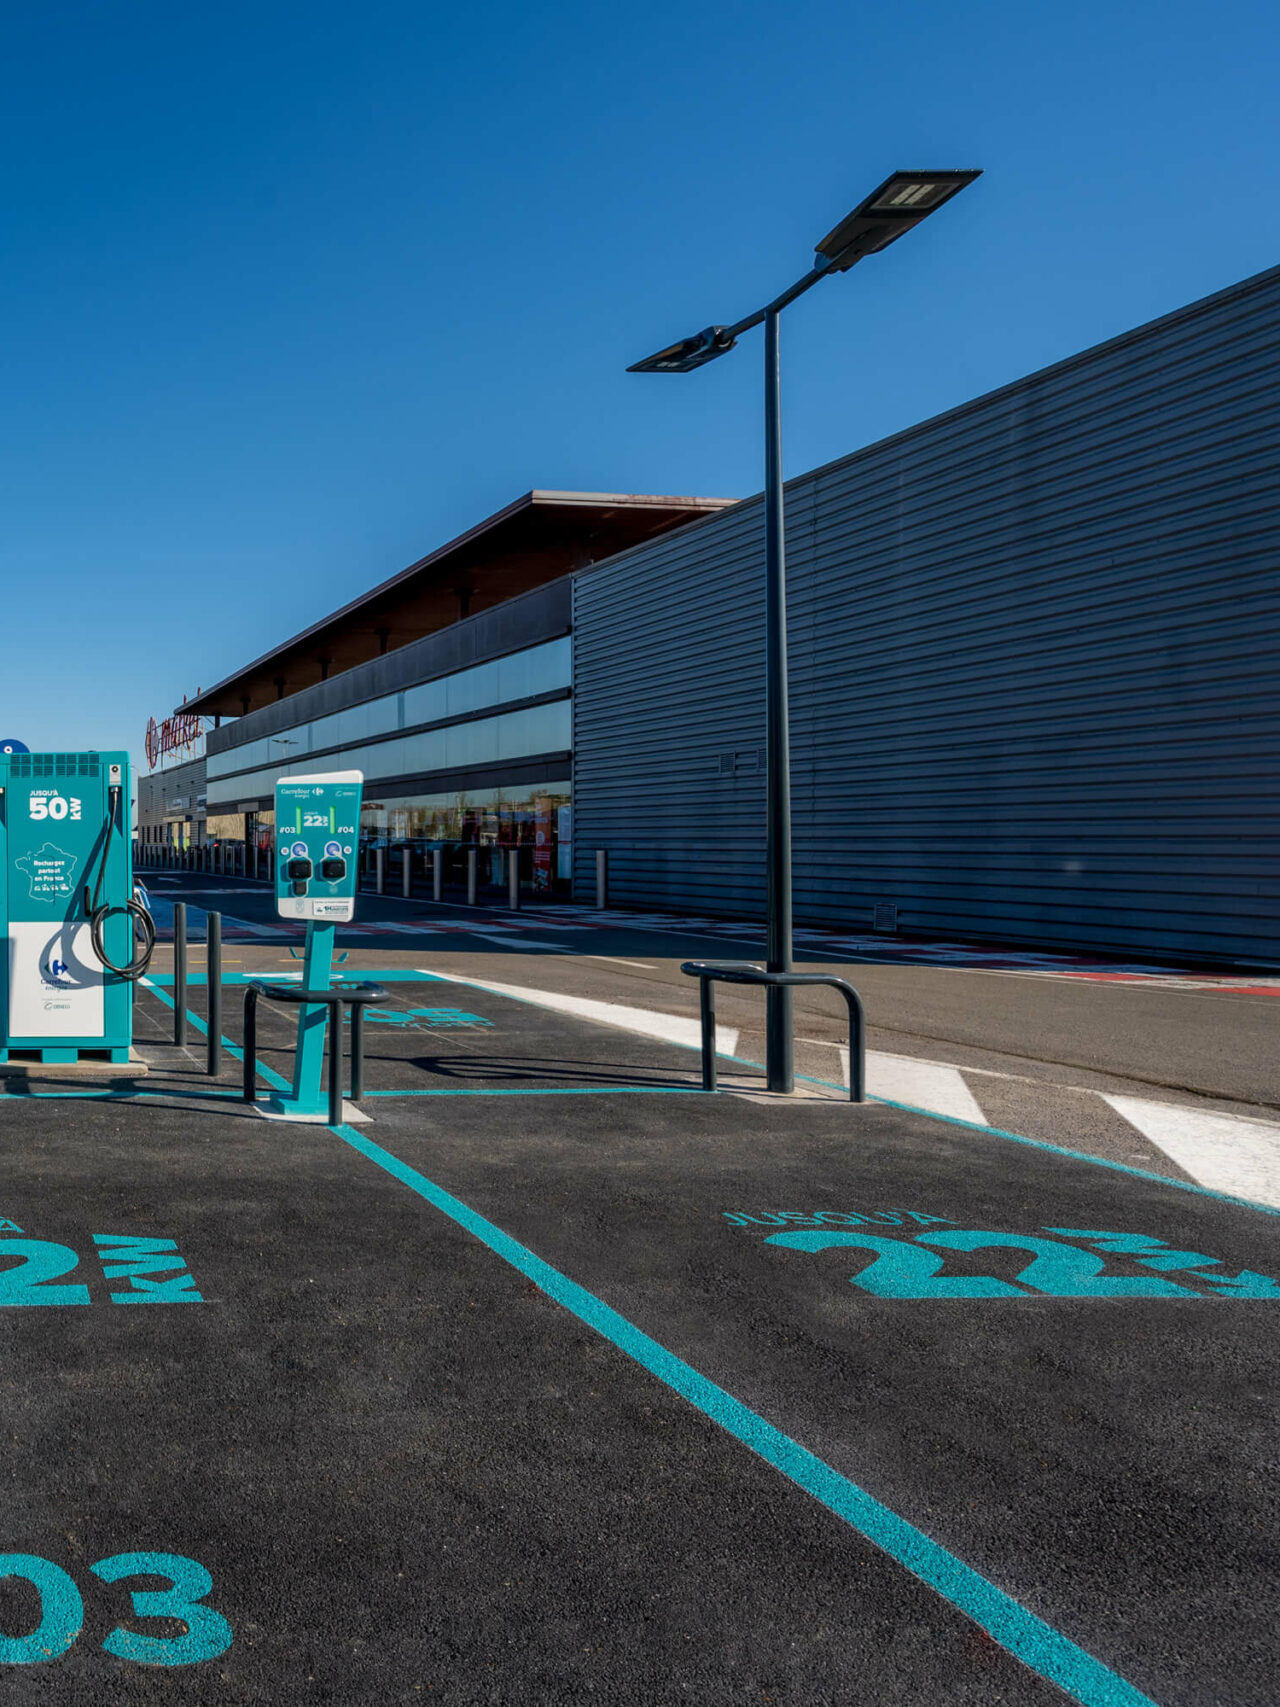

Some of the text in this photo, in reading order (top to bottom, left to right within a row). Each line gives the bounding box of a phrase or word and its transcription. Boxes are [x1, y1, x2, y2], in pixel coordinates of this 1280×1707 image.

[29, 797, 68, 820] 50
[70, 797, 82, 820] kW
[303, 815, 322, 827] 22
[337, 826, 354, 834] #04
[721, 1207, 960, 1226] JUSQU'À
[763, 1230, 1205, 1299] 22
